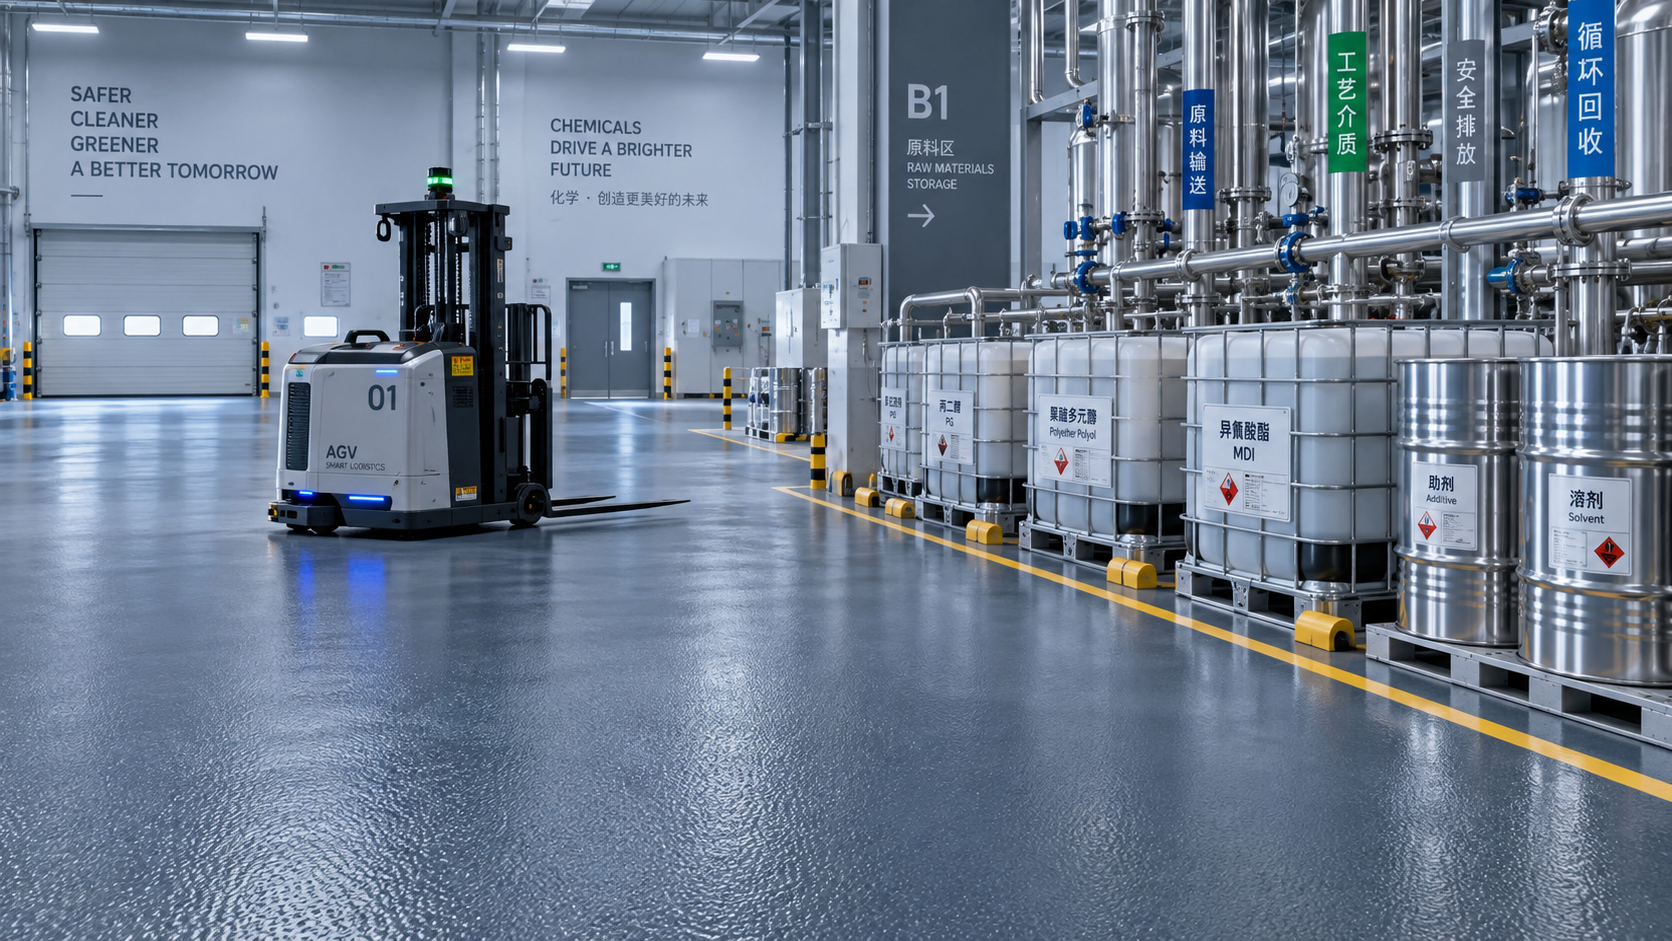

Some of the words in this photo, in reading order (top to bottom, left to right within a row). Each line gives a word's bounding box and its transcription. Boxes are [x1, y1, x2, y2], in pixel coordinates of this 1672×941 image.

[70, 85, 132, 104] SAFER
[907, 83, 948, 120] B1
[1336, 52, 1357, 156] 工艺介质
[1456, 58, 1477, 165] 安全排放
[70, 110, 159, 129] CLEANER
[550, 118, 642, 135] CHEMICALS
[70, 135, 159, 154] GREENER
[550, 140, 598, 156] DRIVE
[601, 141, 613, 156] A
[616, 142, 693, 158] BRIGHTER
[907, 138, 955, 157] 原料区
[70, 160, 84, 177] A
[90, 161, 162, 179] BETTER
[167, 162, 279, 180] TOMORROW
[550, 162, 612, 178] FUTURE
[907, 162, 933, 173] RAW
[934, 163, 995, 175] MATERIALS
[907, 178, 958, 190] STORAGE
[550, 189, 579, 206] 化学
[597, 190, 709, 207] 创造更美好的未来
[367, 384, 397, 411] 01
[325, 444, 358, 460] AGV
[1233, 446, 1255, 462] MDI
[325, 461, 348, 471] SMART
[1428, 474, 1455, 493] 助剂
[1425, 494, 1457, 506] Additive
[1569, 488, 1604, 510] 溶剂
[1568, 512, 1605, 525] Solvent
